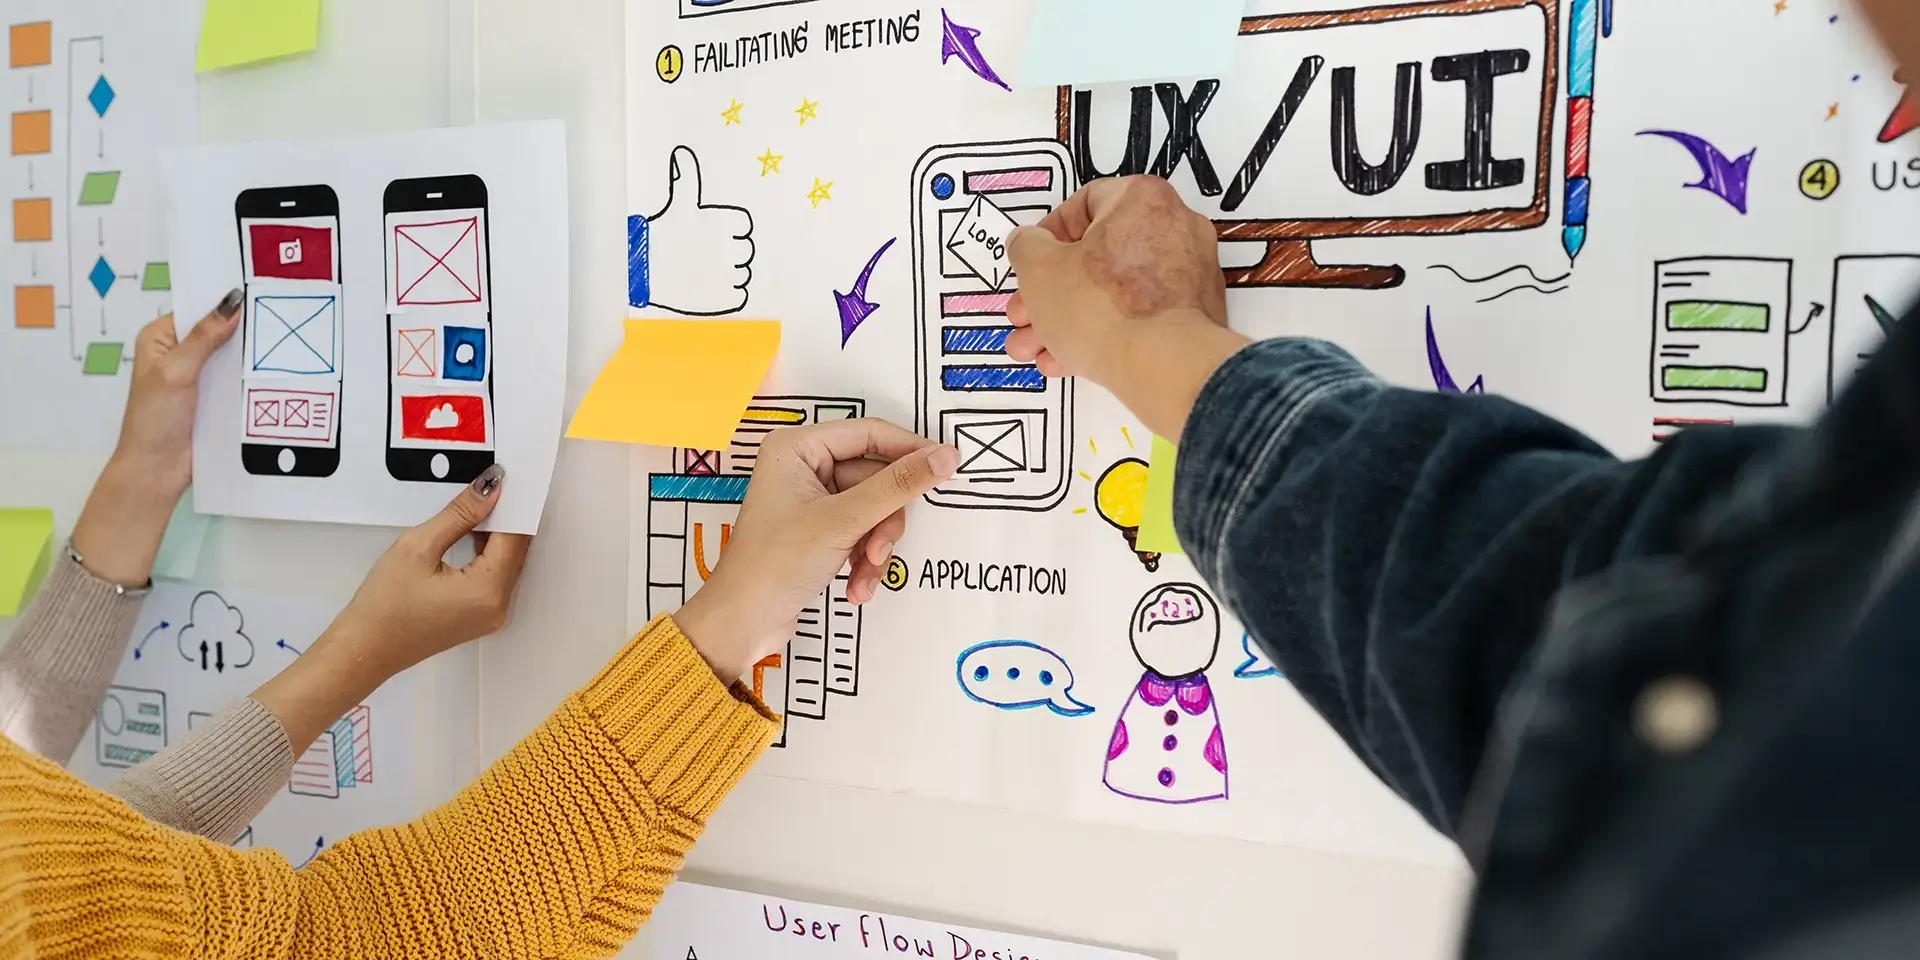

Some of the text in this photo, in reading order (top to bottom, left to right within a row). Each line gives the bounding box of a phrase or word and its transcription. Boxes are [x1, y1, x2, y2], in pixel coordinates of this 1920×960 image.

[694, 20, 809, 74] FAILITATING
[825, 9, 921, 53] MEETING
[918, 558, 1067, 596] APPLICATION
[763, 903, 841, 942] User
